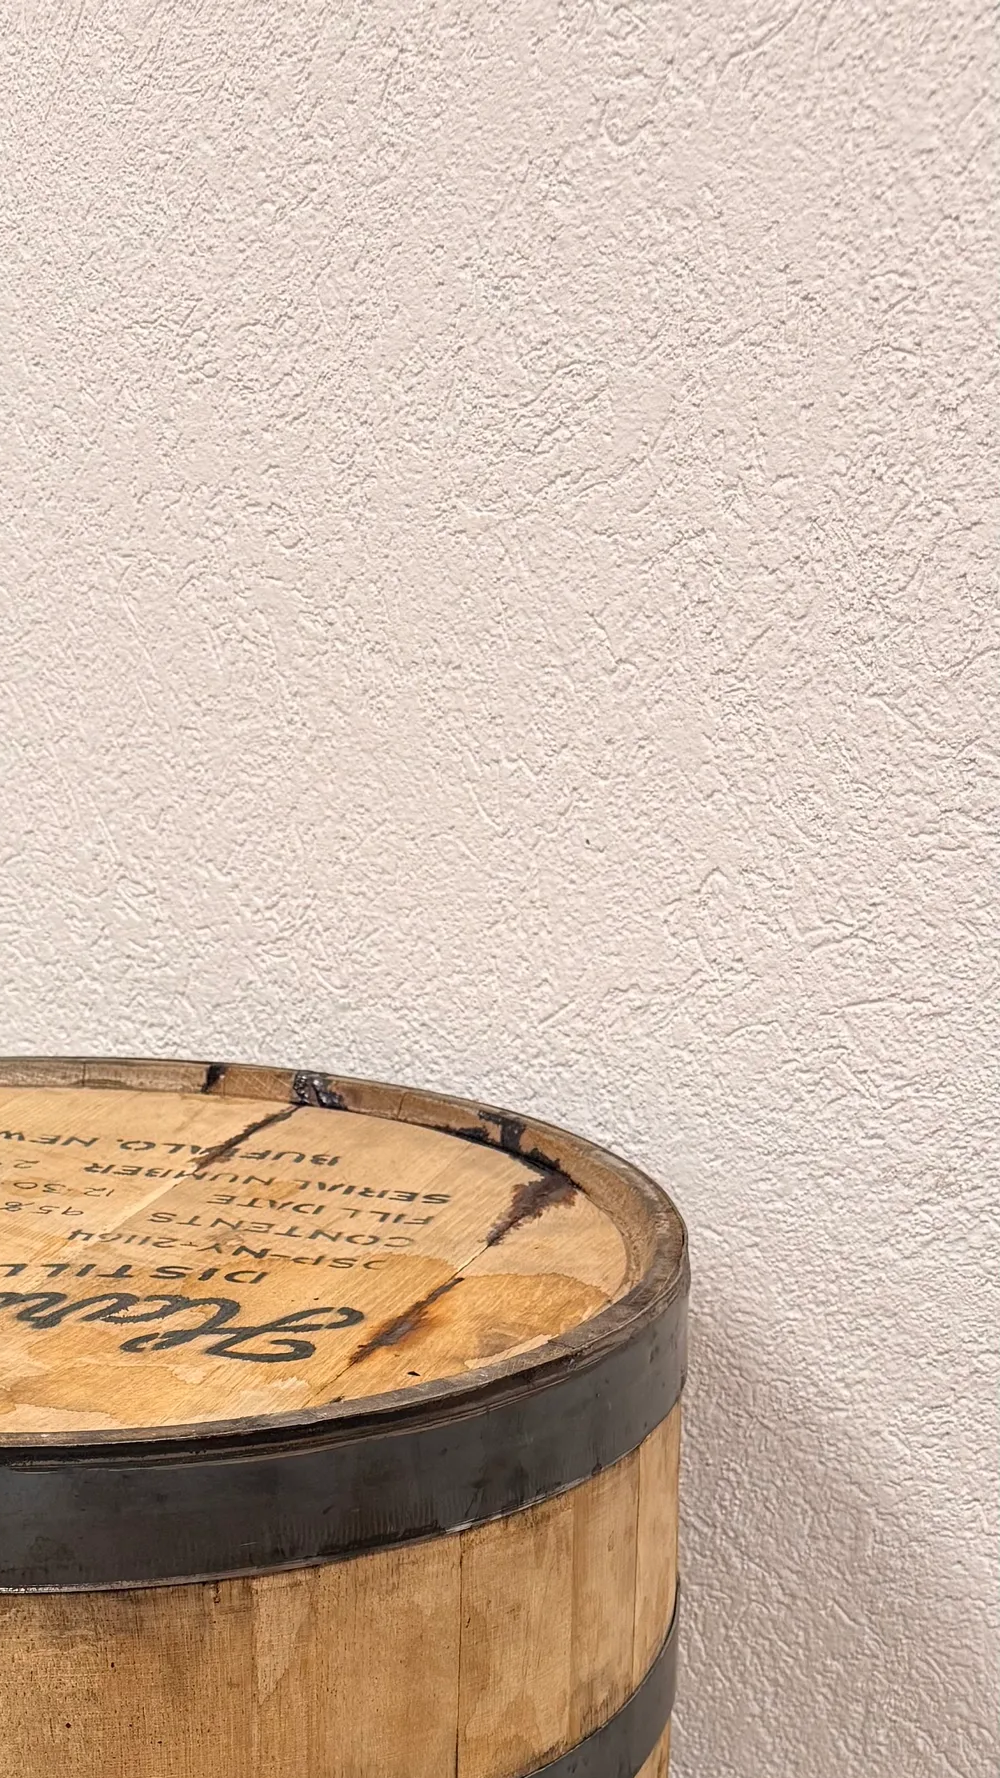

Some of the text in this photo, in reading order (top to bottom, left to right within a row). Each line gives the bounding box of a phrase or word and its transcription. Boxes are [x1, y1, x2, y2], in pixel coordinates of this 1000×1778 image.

[83, 1162, 452, 1205] SERIAL NUMBER
[207, 1193, 434, 1226] FILL DATE
[147, 1212, 415, 1247] CONTENTS
